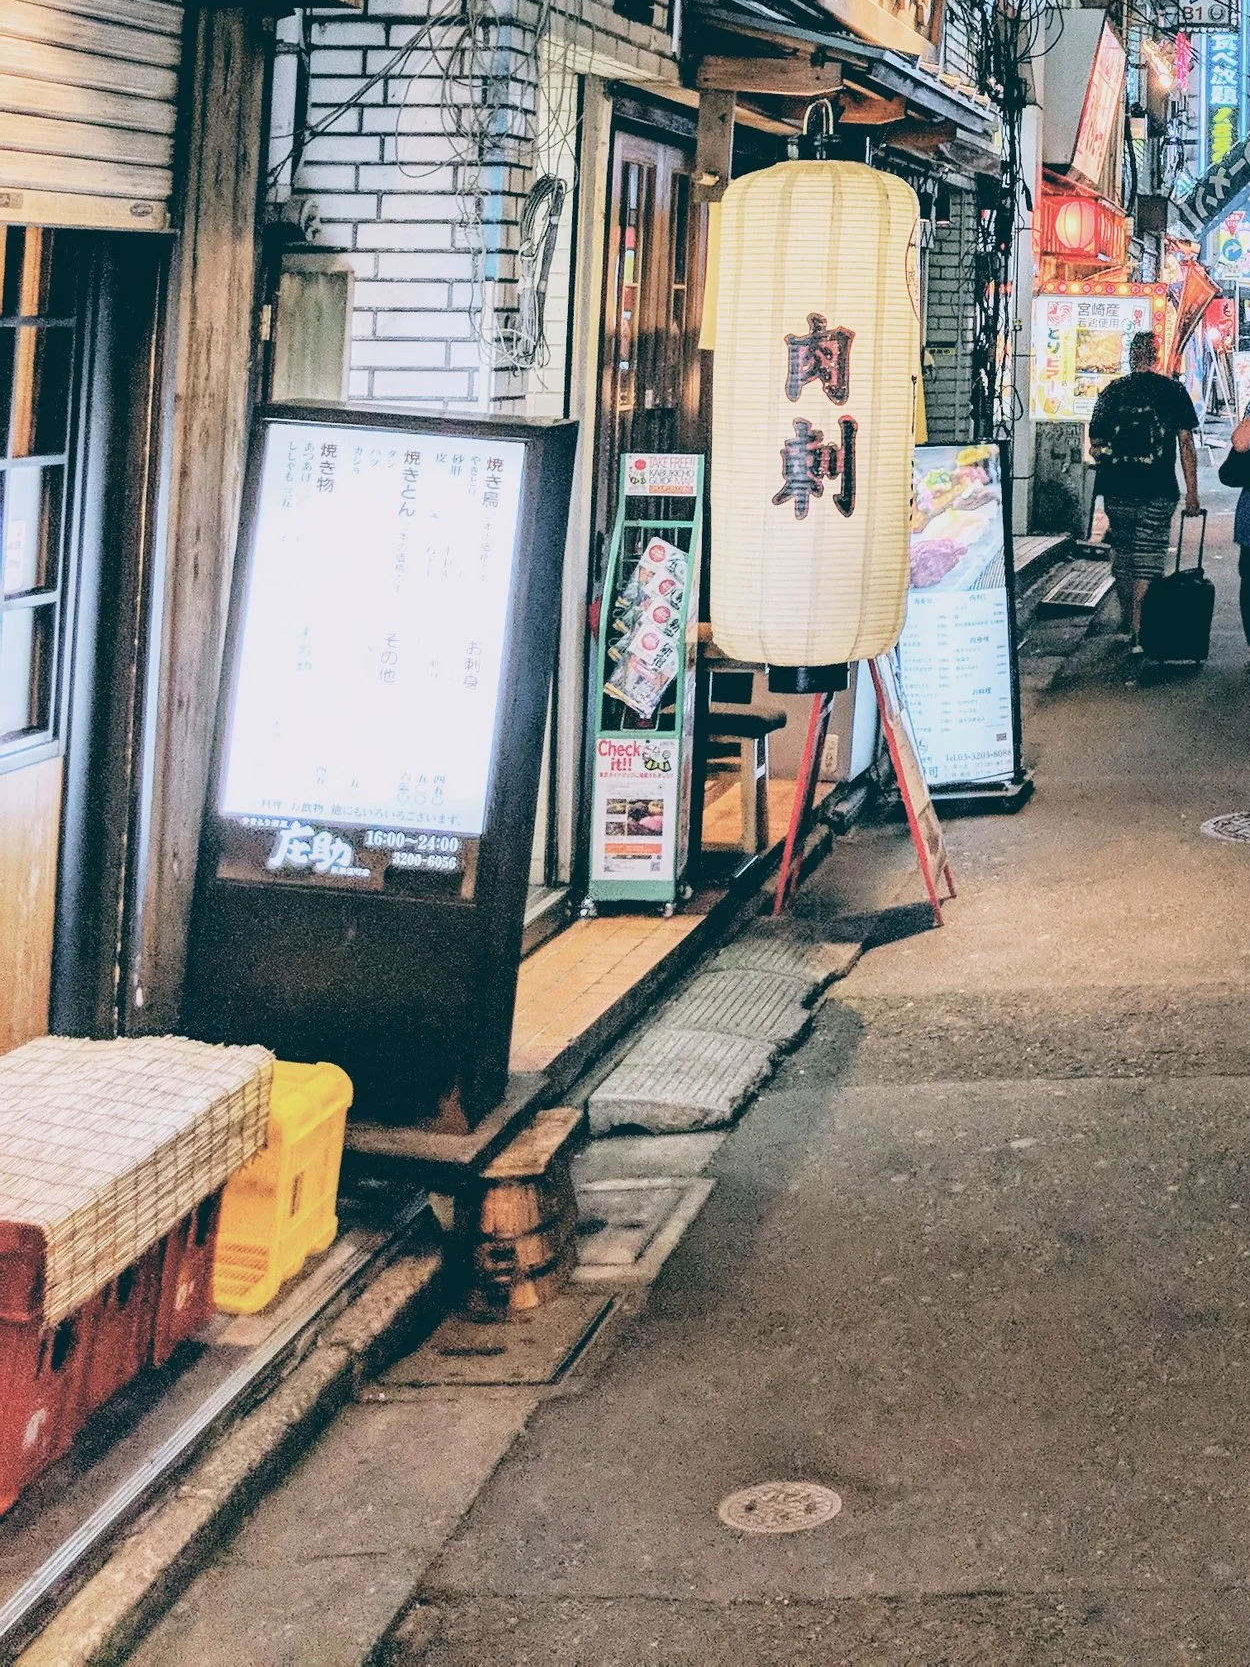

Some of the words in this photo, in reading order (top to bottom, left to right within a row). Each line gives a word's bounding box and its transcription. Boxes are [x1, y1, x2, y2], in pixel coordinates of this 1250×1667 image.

[1210, 34, 1239, 105] 食べ放題
[1078, 302, 1120, 317] 宮崎産
[772, 312, 859, 521] 肉刺
[316, 443, 338, 493] 焼き物
[397, 450, 421, 518] 焼きとん
[598, 740, 640, 756] Check
[611, 758, 632, 771] it!!
[267, 821, 352, 872] 庄助
